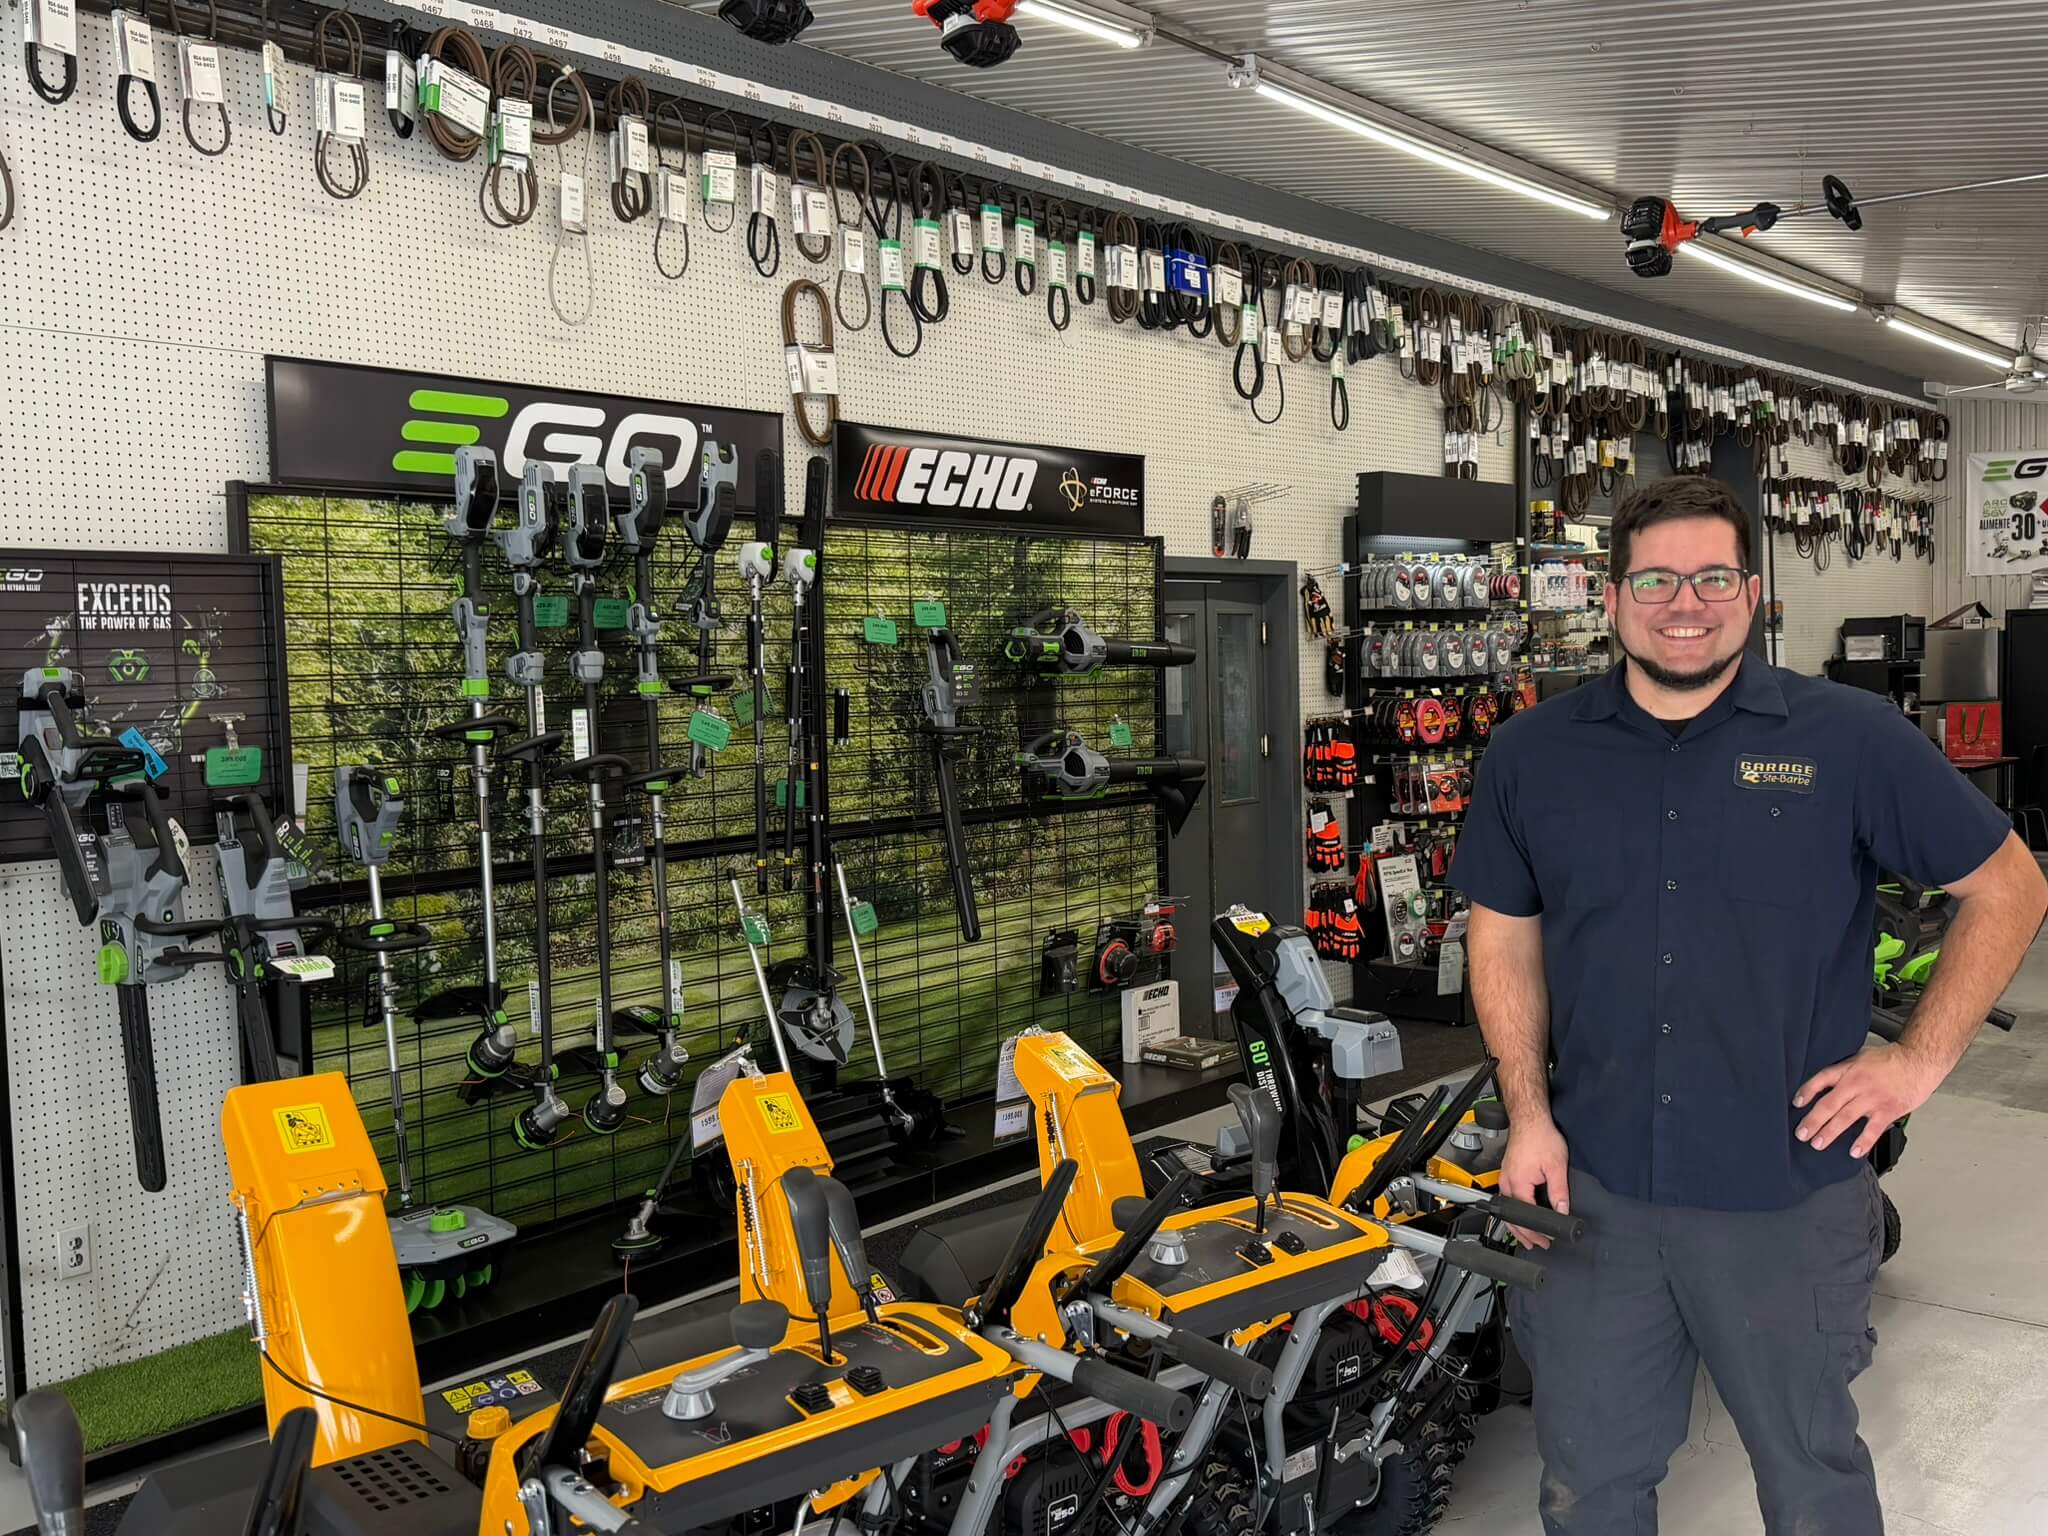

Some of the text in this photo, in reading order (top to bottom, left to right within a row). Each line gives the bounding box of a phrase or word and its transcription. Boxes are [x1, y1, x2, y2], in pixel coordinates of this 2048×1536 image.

[421, 4, 443, 16] 0467
[474, 18, 495, 29] 0468
[513, 28, 534, 39] 0472
[549, 37, 568, 49] 0497
[392, 389, 698, 489] EGO
[1982, 457, 2048, 481] EG
[895, 446, 1039, 513] ECHO
[1979, 519, 2011, 531] ALIMENTE
[2011, 513, 2036, 542] 30
[77, 582, 172, 616] EXCEEDS
[79, 616, 172, 631] THE POWER OF GAS
[1740, 761, 1815, 776] GARAGE
[1762, 774, 1811, 786] Ste-Barbe
[1148, 985, 1170, 1000] ECHO
[463, 1236, 486, 1248] EGO
